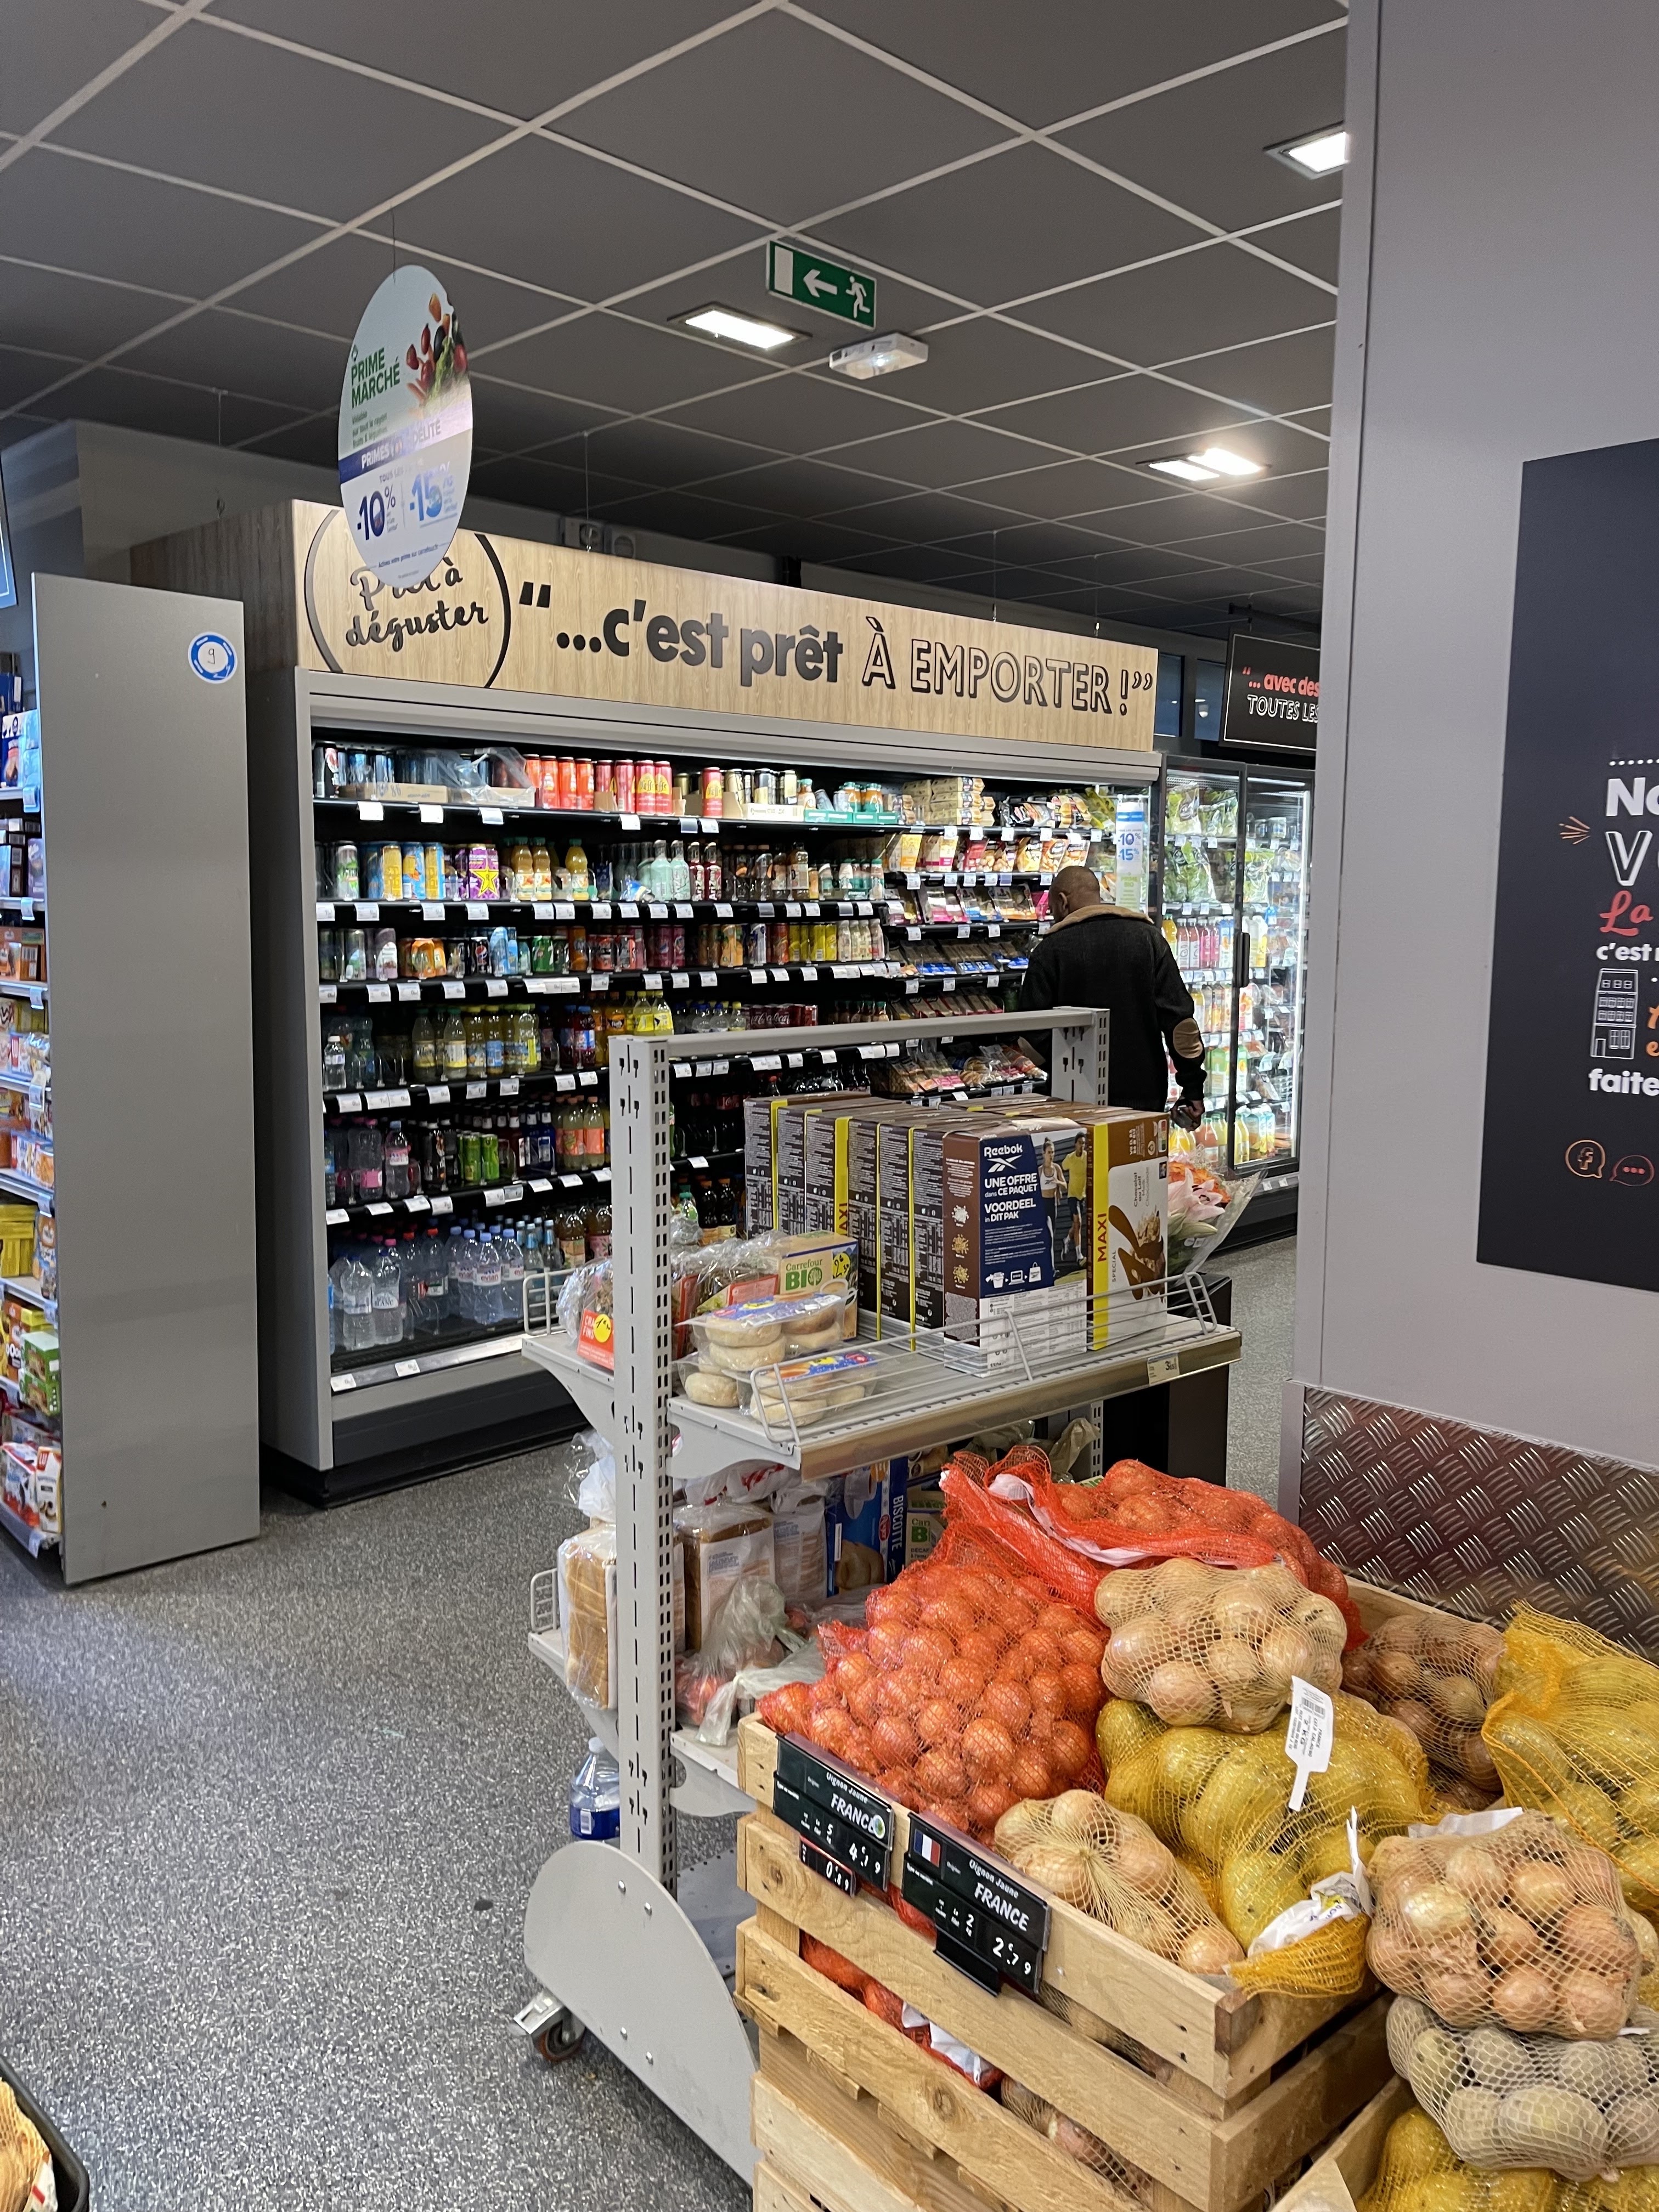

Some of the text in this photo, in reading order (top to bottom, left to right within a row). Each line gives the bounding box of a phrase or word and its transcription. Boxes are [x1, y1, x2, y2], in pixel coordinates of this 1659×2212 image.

[352, 347, 385, 386] PRIME
[352, 356, 400, 409] MARCHÉ
[362, 443, 390, 469] PRIMES
[445, 557, 463, 586] à
[346, 600, 489, 652] déguster
[740, 623, 844, 687] prêt
[861, 615, 896, 690] À
[910, 638, 1113, 715] EMPORTER
[1263, 673, 1297, 694] avec
[1298, 676, 1320, 697] des
[1247, 694, 1300, 720] TOUTES
[1118, 832, 1141, 846] -10%
[1118, 848, 1140, 861] -15%
[1599, 890, 1654, 936] La
[1596, 943, 1653, 962] c'est
[984, 1143, 1023, 1158] Reebok
[985, 1176, 1006, 1188] UNE
[1007, 1172, 1037, 1186] OFFRE
[997, 1187, 1008, 1196] CE
[1008, 1183, 1038, 1195] PAQUET
[985, 1198, 1036, 1214] VOORDEEL
[991, 1213, 1003, 1222] DIT
[1004, 1210, 1019, 1221] PAK
[839, 1203, 848, 1237] AXI
[1097, 1212, 1107, 1262] MAXI
[786, 1259, 823, 1272] Carrefour
[891, 1494, 904, 1551] BISCOTTE
[826, 1771, 868, 1804] Oignon Jaune
[831, 1792, 876, 1835] FRANCE
[827, 1823, 833, 1836] 5
[969, 1859, 1019, 1899] Oignon Jaune
[974, 1882, 1030, 1932] FRANCE
[966, 1913, 975, 1928] 2
